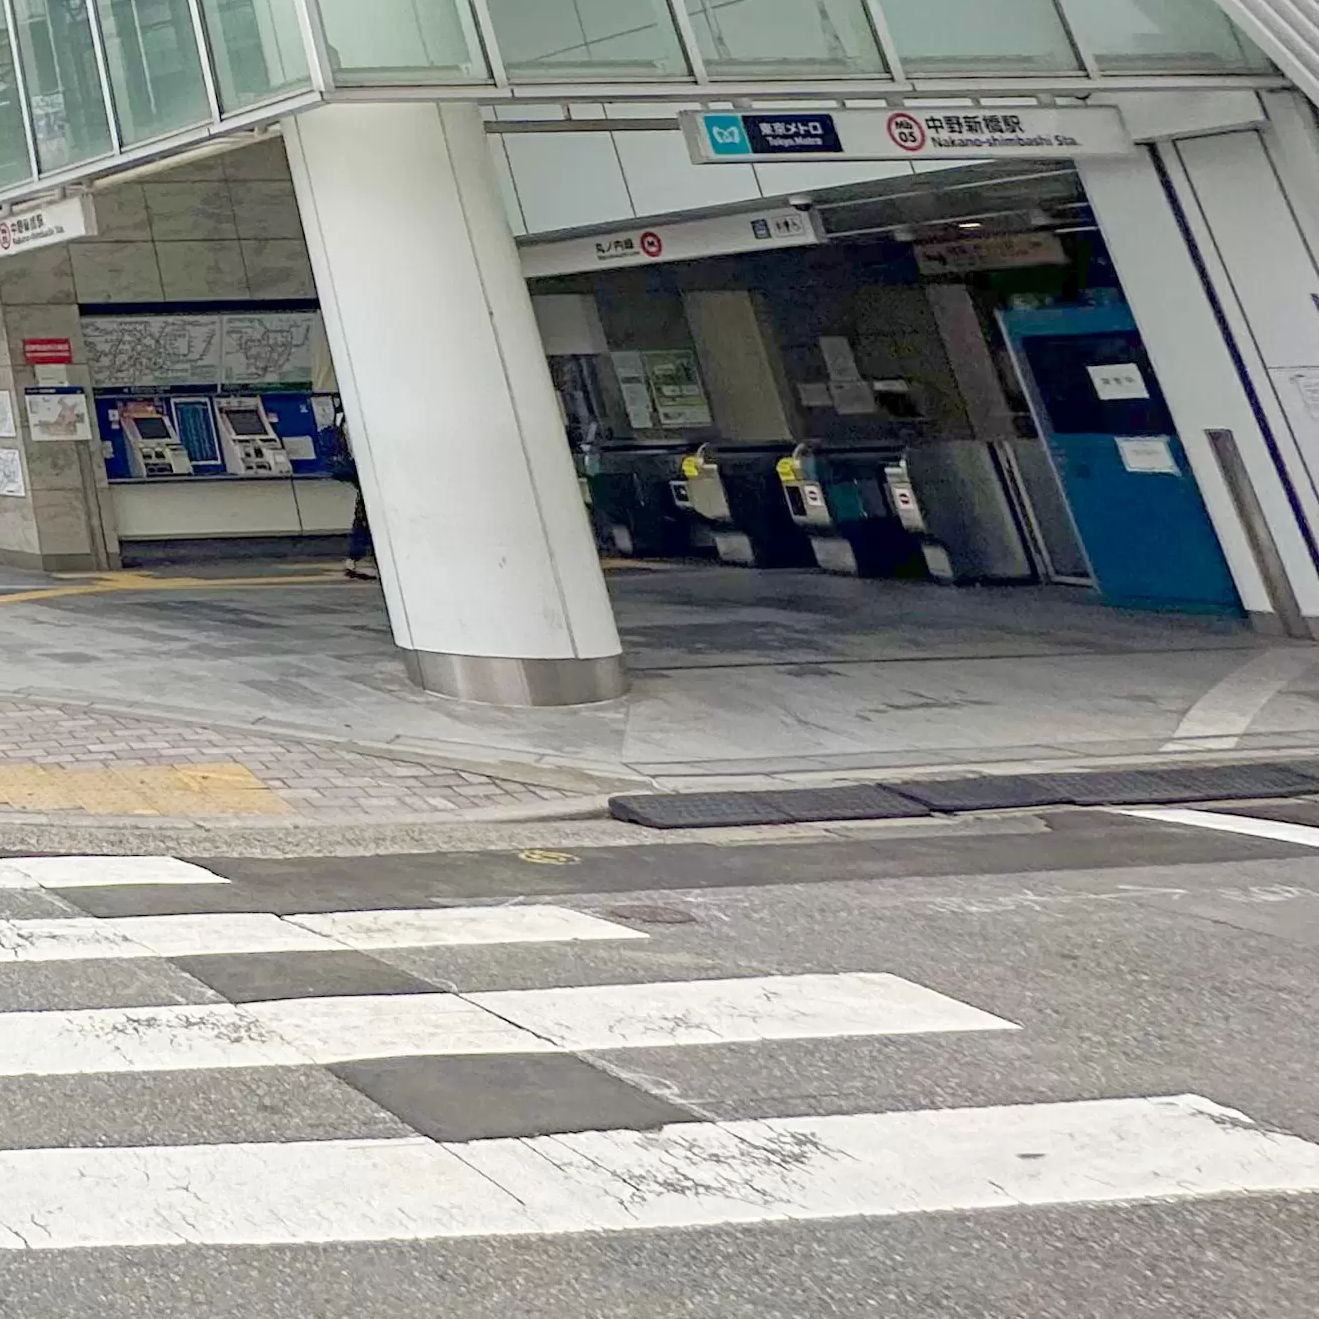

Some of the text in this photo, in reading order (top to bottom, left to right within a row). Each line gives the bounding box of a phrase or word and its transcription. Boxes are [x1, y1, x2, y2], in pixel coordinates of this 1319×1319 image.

[759, 121, 824, 136] 東京メトロ
[925, 115, 1025, 134] 中野新橋駅
[898, 132, 917, 143] 05
[930, 134, 1052, 148] Nakano-shimbashi
